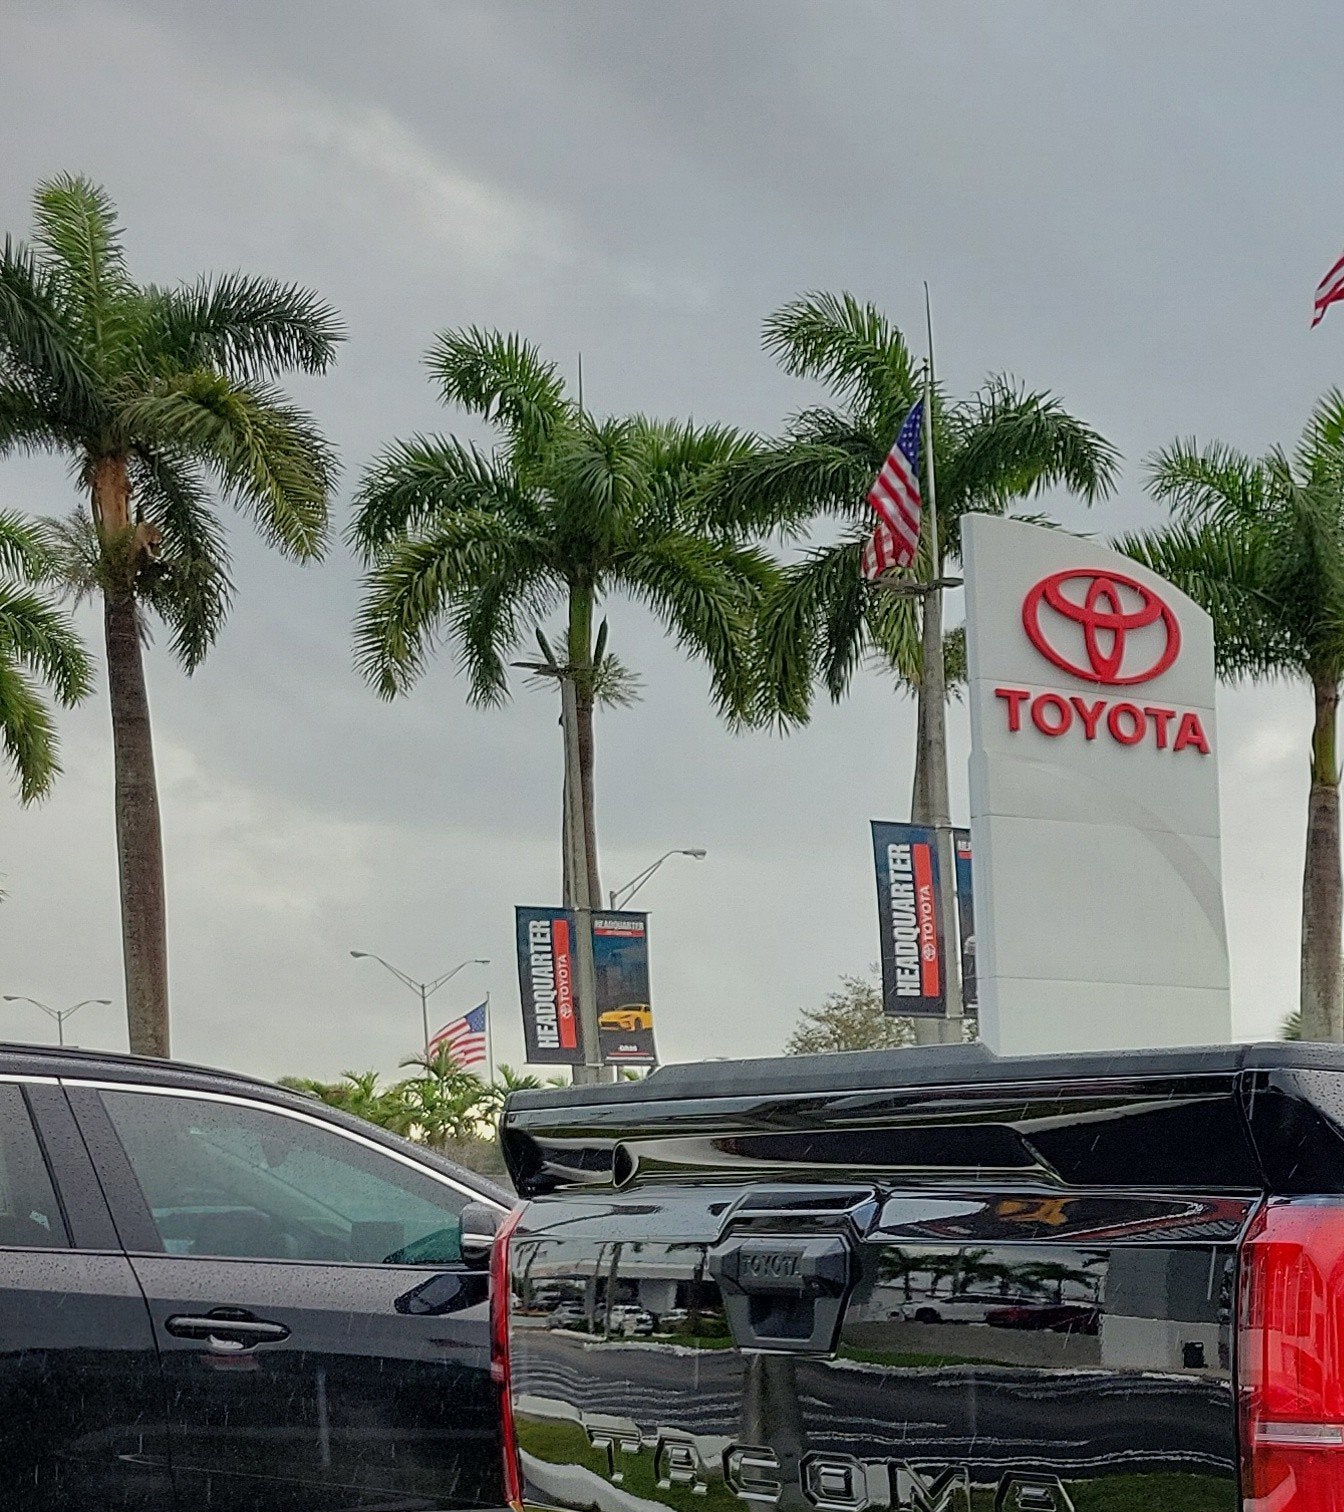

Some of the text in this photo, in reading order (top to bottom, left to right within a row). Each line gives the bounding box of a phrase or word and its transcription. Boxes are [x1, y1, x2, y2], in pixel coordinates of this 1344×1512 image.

[994, 688, 1212, 756] TOYOTA
[888, 842, 921, 997] HEADQUARTER
[919, 884, 935, 941] TOYOTA
[529, 919, 560, 1049] HEADQUARTER
[558, 954, 570, 1001] TOYOTA
[741, 1254, 801, 1277] TOYOTA
